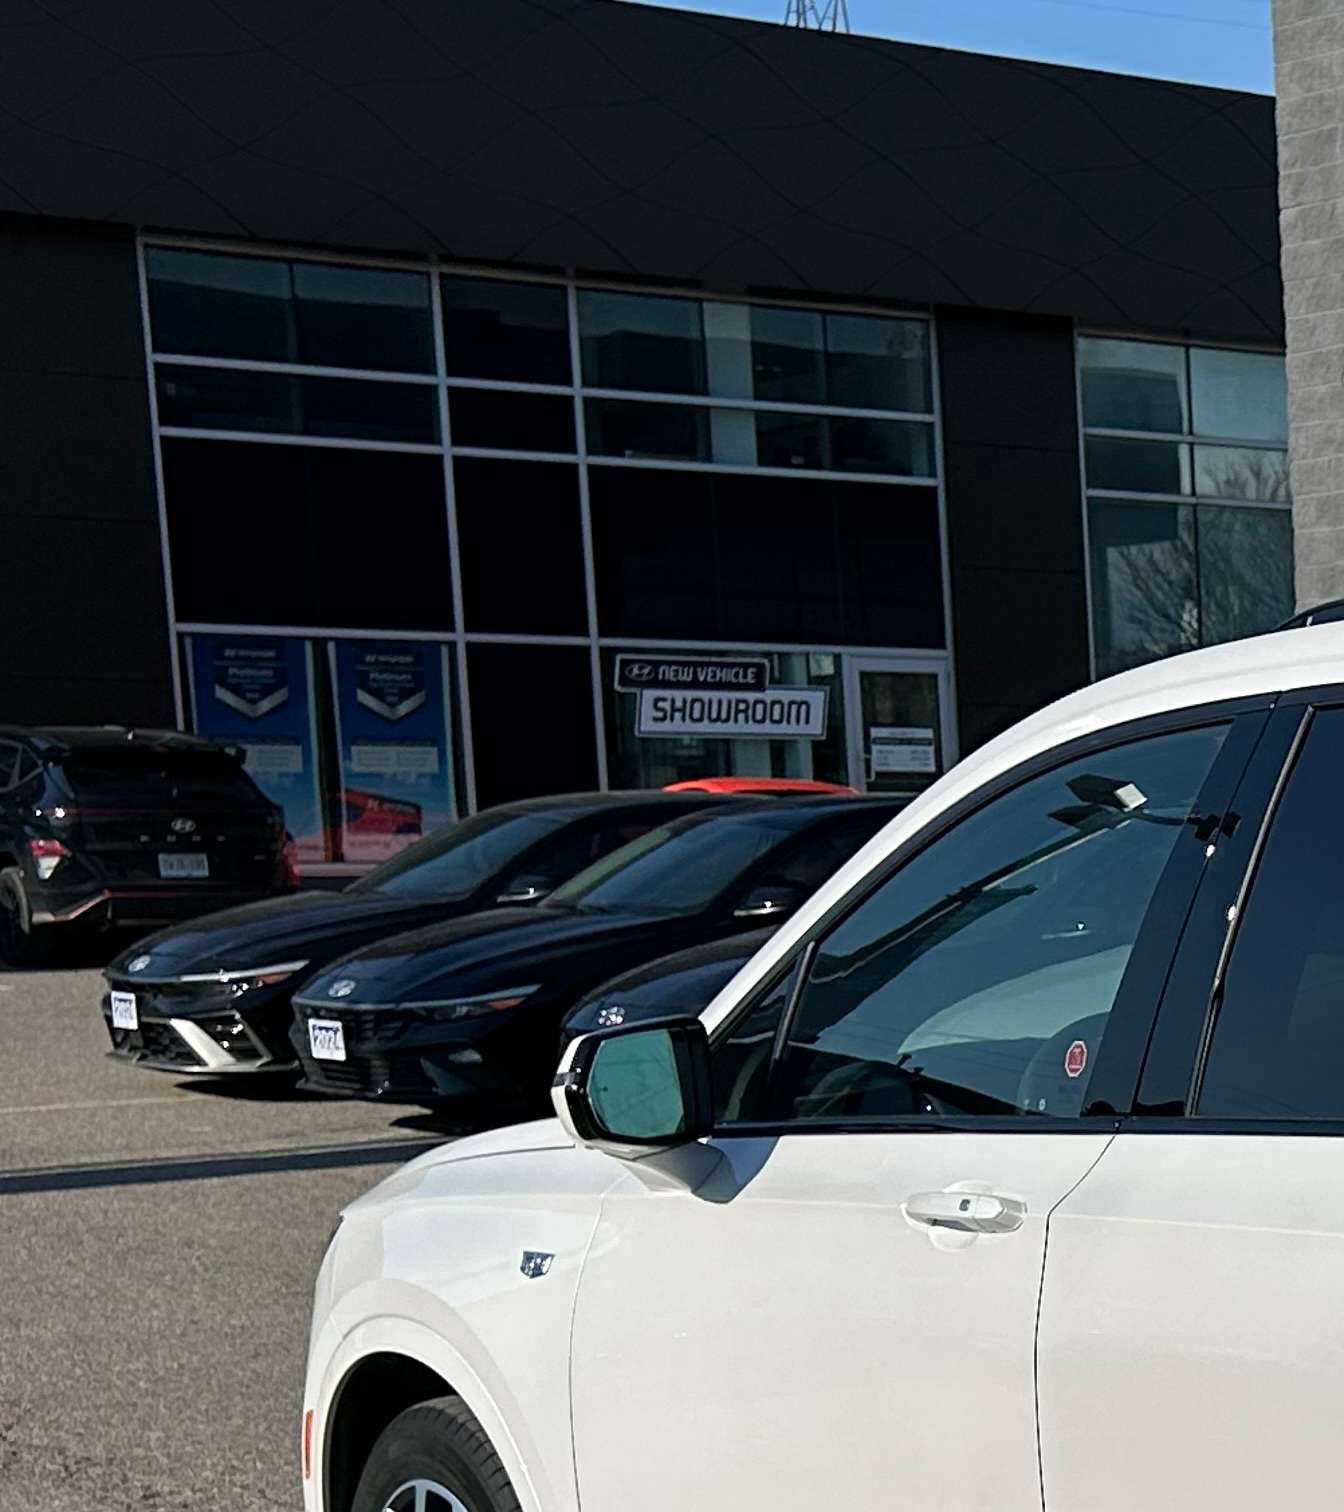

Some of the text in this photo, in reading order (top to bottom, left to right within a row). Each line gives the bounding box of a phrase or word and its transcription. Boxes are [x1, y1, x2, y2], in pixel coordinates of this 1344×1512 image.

[658, 665, 757, 683] NEW VEHICLE
[652, 697, 811, 726] SHOWROOM
